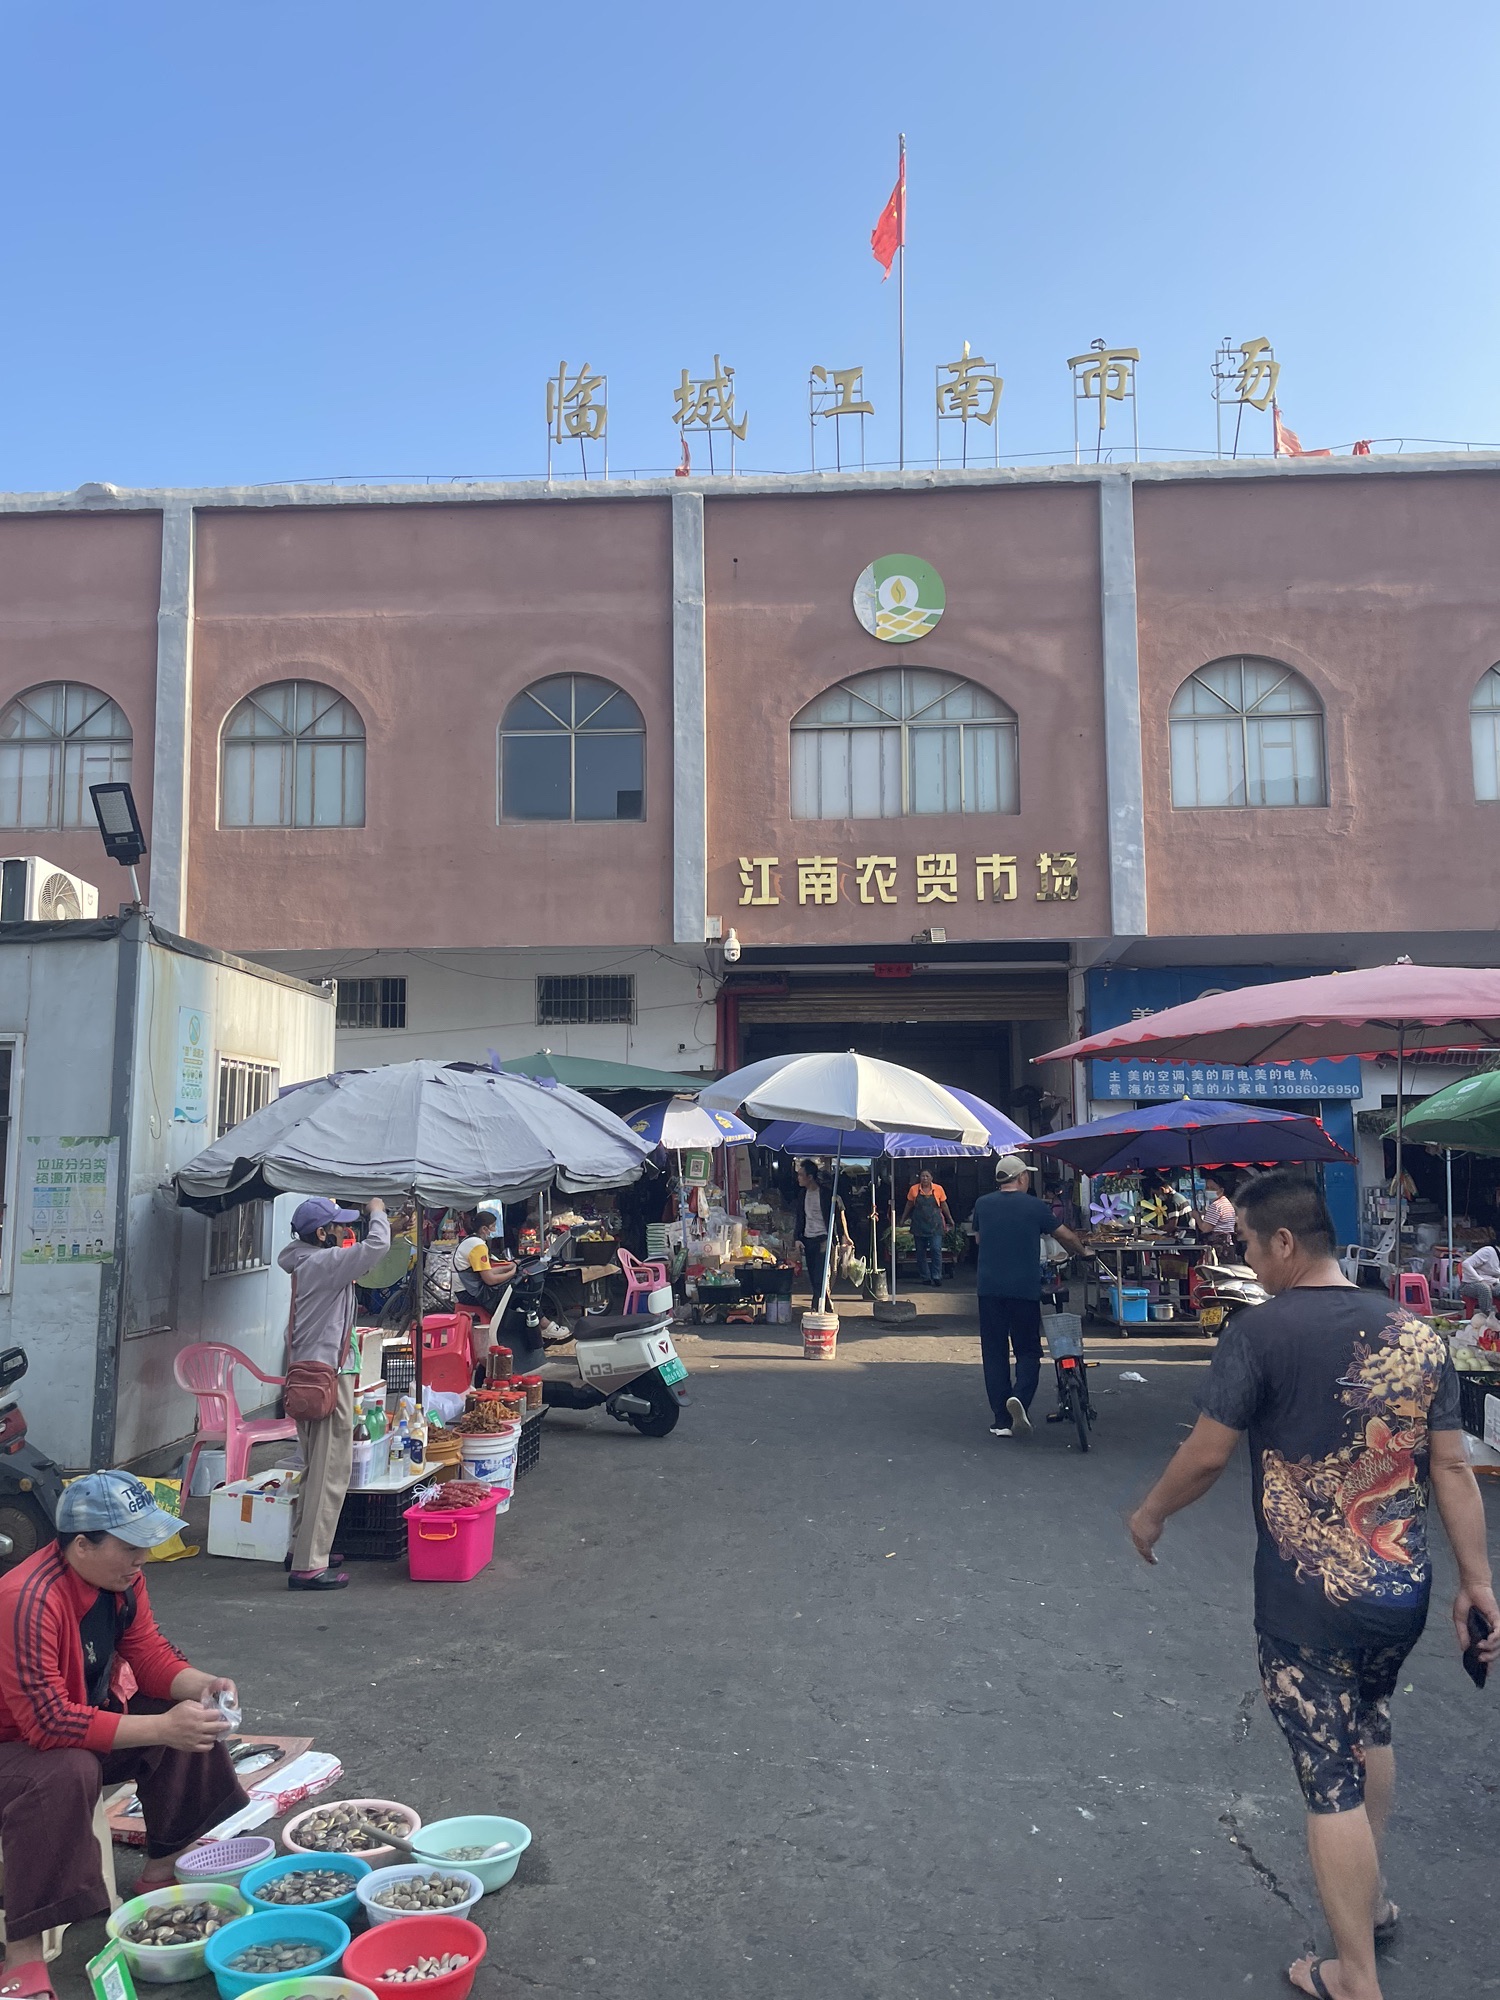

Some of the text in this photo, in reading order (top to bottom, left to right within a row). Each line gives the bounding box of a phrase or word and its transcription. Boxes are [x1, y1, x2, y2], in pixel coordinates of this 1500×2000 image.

[546, 337, 1281, 444] 临城江南市场
[738, 852, 1080, 906] 江南农贸市场
[1272, 1084, 1360, 1095] 13086026950
[37, 1158, 106, 1171] 垃圾分分类
[35, 1172, 106, 1184] 资源不浪费
